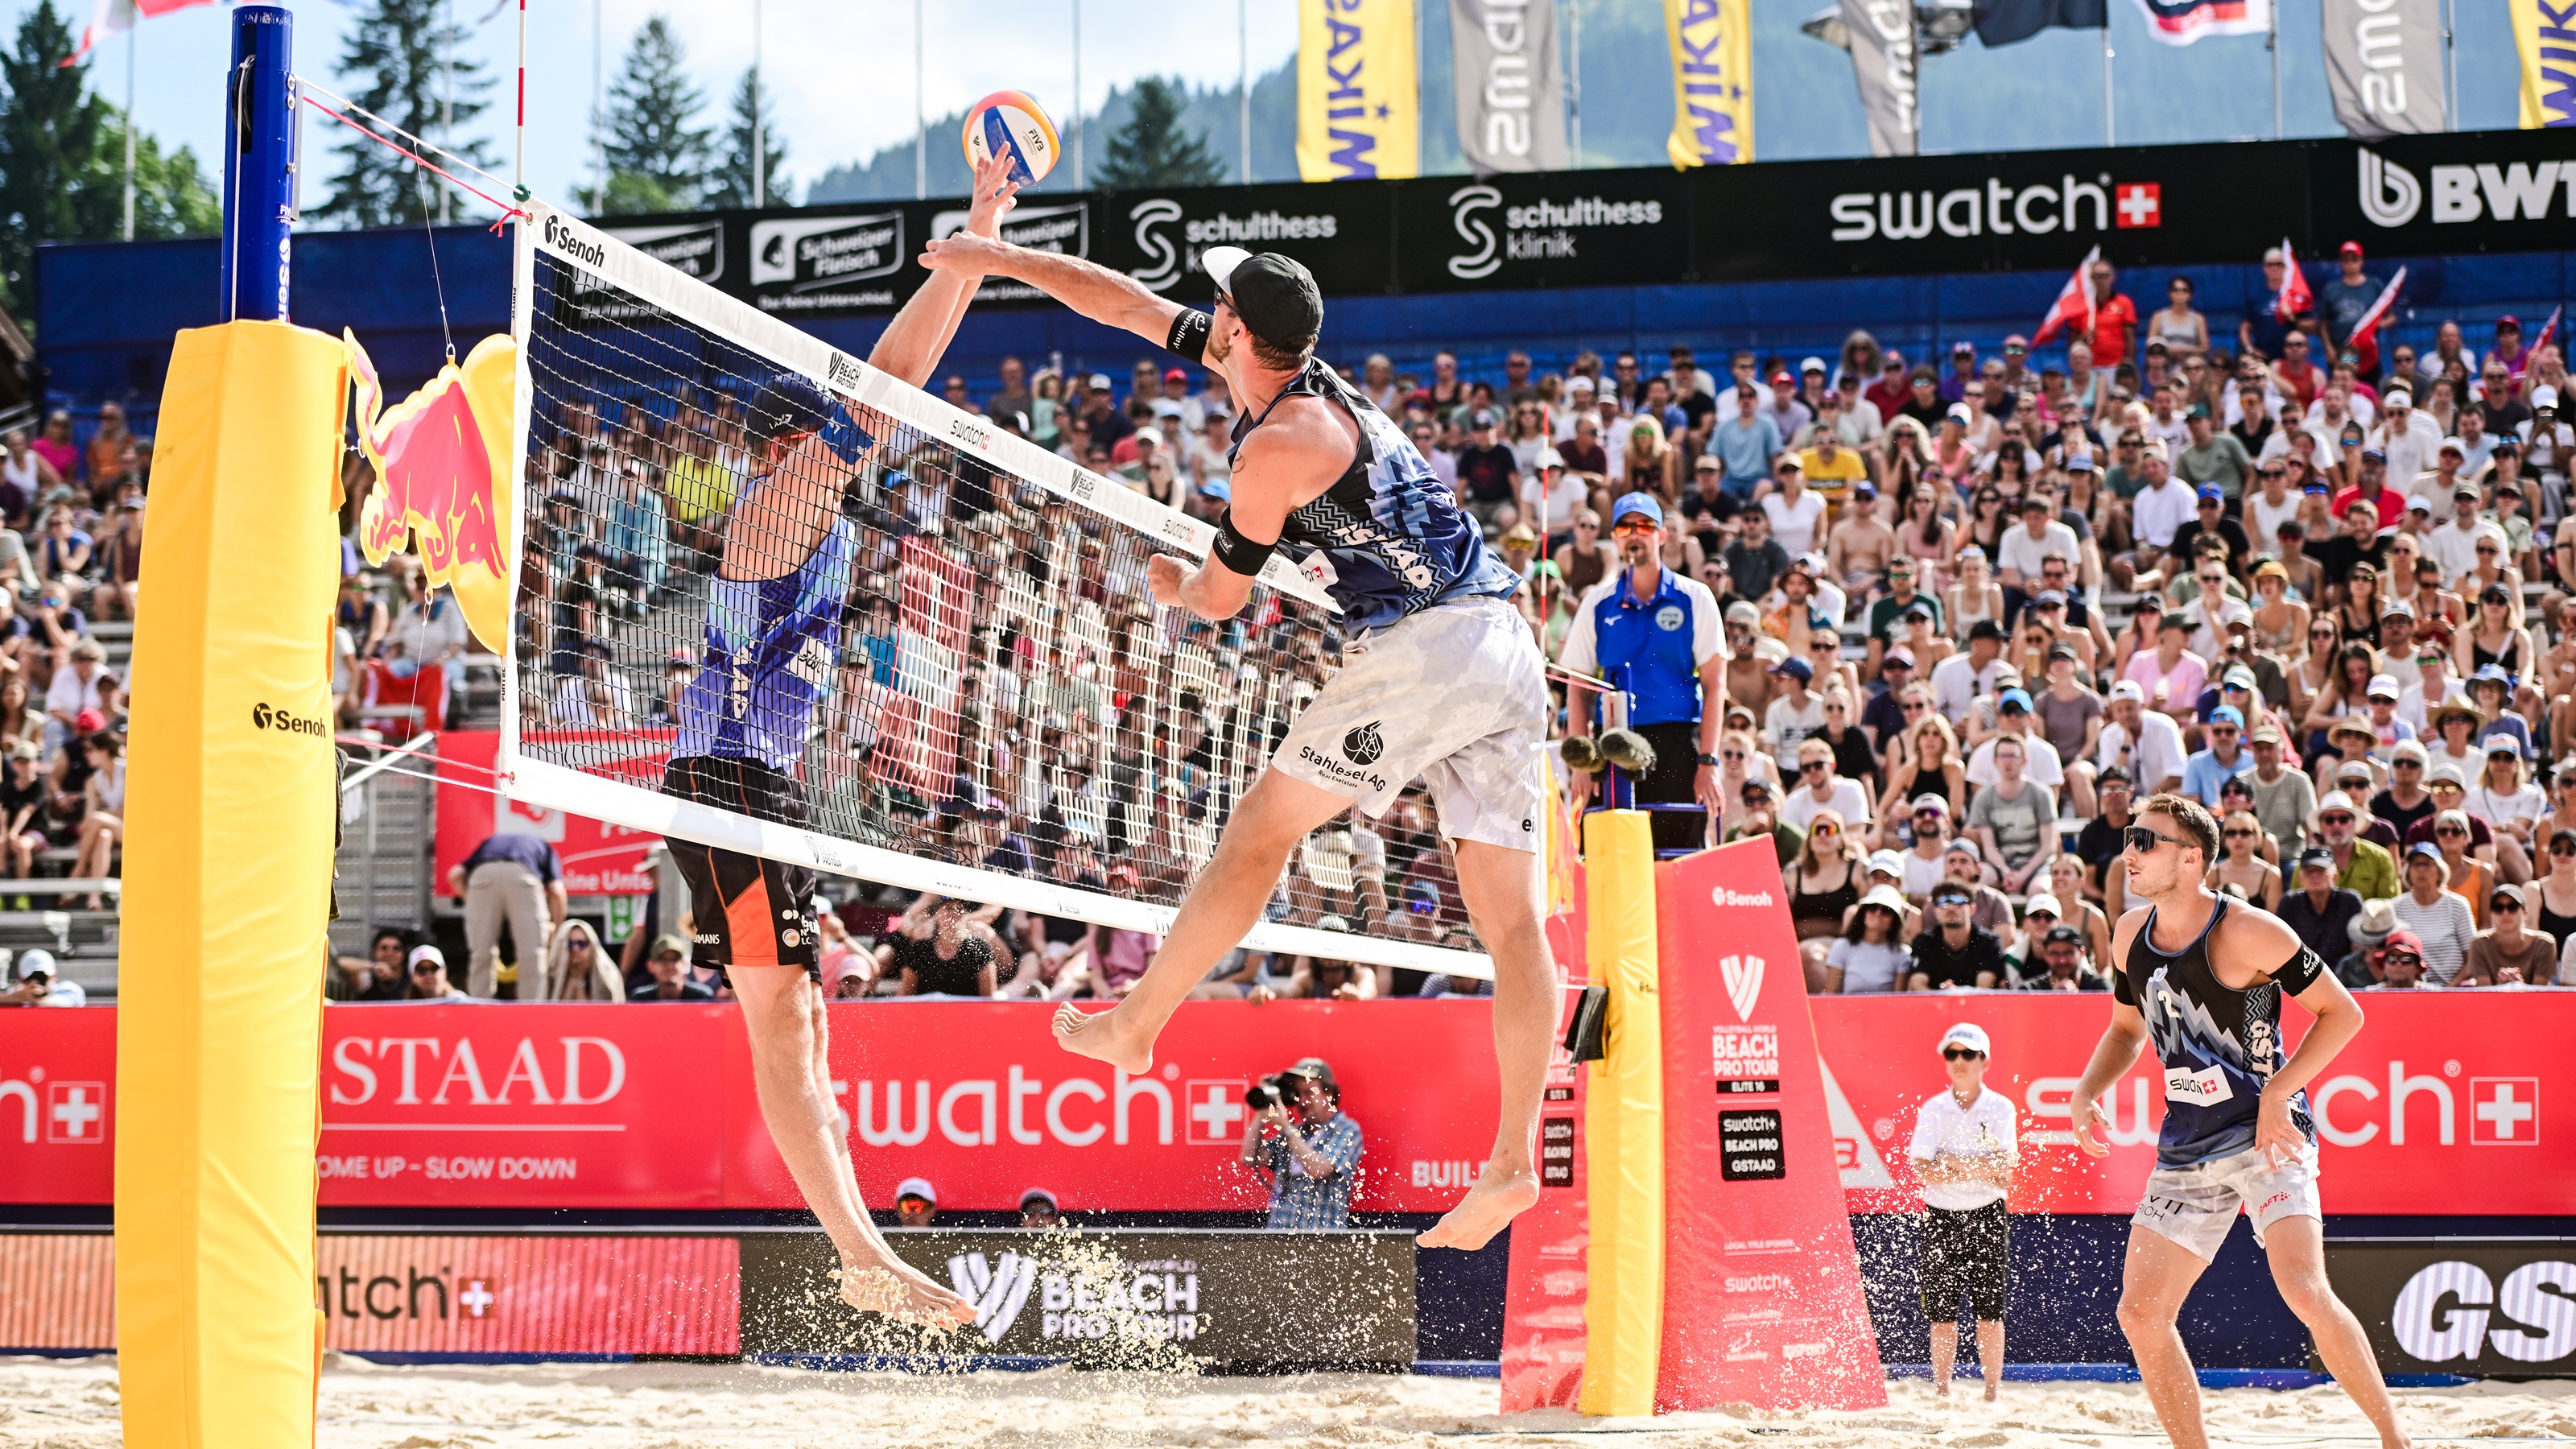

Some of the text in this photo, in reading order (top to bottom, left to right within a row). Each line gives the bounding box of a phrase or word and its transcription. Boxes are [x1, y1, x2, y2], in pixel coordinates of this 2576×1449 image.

[1507, 197, 1662, 229] schulthess
[1831, 175, 2107, 242] swatch
[1186, 210, 1337, 242] schulthess
[558, 226, 605, 268] Senoh
[1507, 231, 1577, 259] klinik
[279, 264, 290, 322] Sen
[839, 362, 861, 382] BEACH
[951, 419, 985, 448] swatch
[275, 710, 326, 739] Senoh
[1300, 746, 1385, 791] Stahlesel AG
[1726, 890, 1773, 906] Senoh
[2158, 990, 2180, 1018] 2
[1712, 1034, 1778, 1059] BEACH
[330, 1036, 626, 1106] STAAD
[1713, 1059, 1779, 1076] PRO TOUR
[1725, 1137, 1778, 1152] BEACH PRO
[316, 1156, 369, 1179] OME
[374, 1157, 406, 1179] UP
[425, 1157, 495, 1179] SLOW
[499, 1157, 576, 1179] DOWN
[1412, 1160, 1489, 1188] BUIL
[1732, 1158, 1776, 1172] GSTAAD
[1042, 1274, 1199, 1312] BEACH
[1724, 1273, 1781, 1293] swatch
